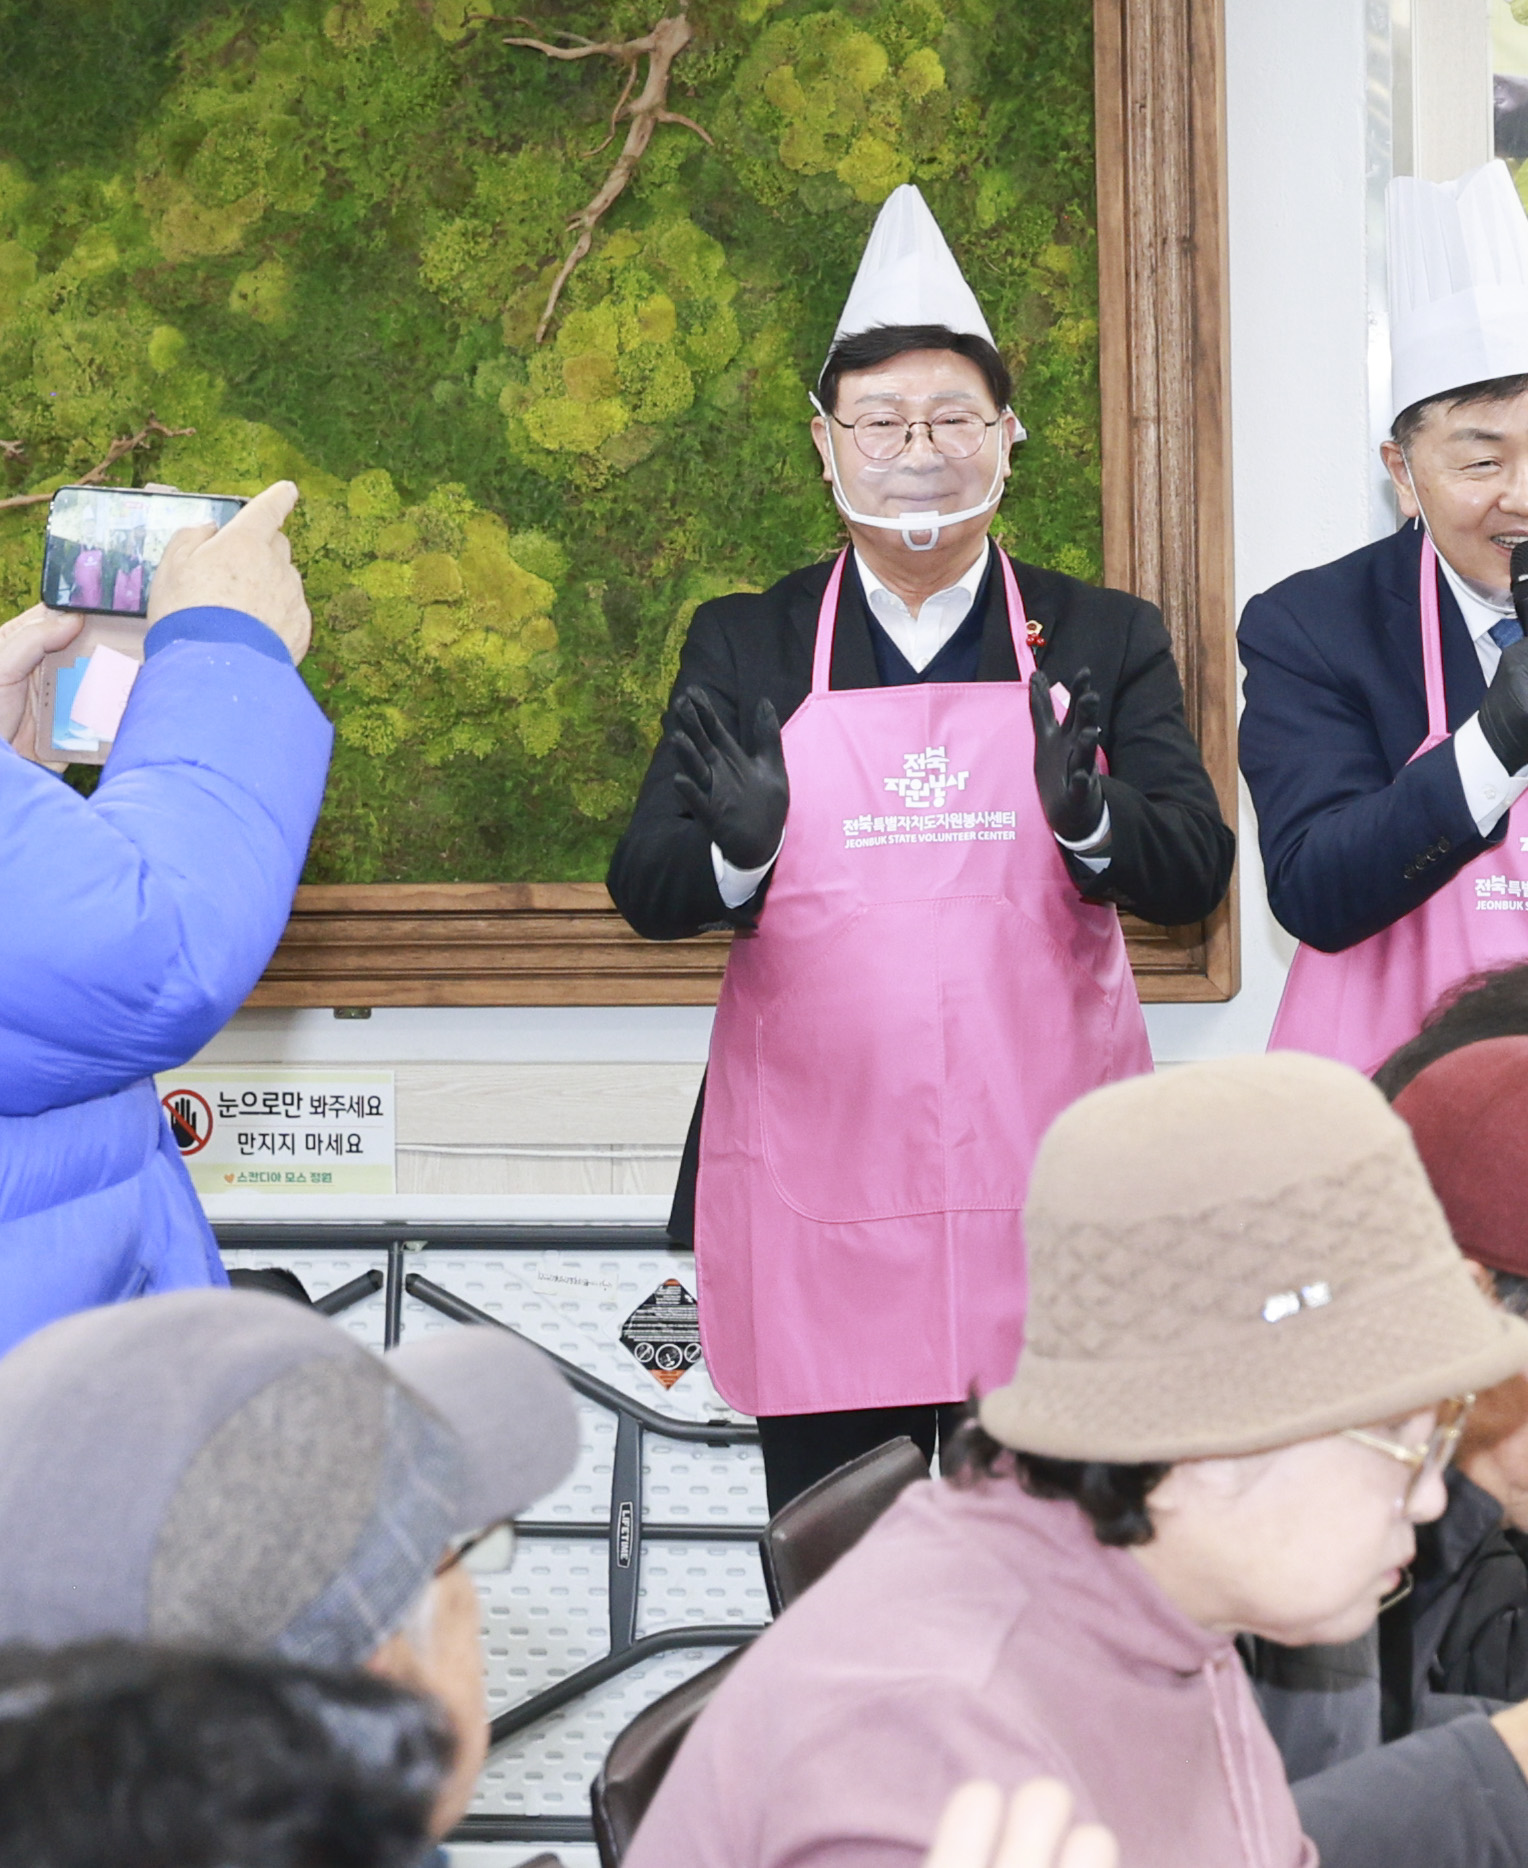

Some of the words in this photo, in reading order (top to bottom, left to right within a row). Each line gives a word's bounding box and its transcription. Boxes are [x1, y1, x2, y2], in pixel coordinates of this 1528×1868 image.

[903, 746, 950, 777] 전북
[883, 771, 969, 809] 자원봉사
[842, 811, 1016, 836] 전북특별자치도자원봉사센터
[844, 835, 887, 849] JEONBUK
[888, 834, 918, 844] STATE
[918, 831, 977, 843] VOLUNTEER
[978, 830, 1016, 842] CENTER
[1475, 899, 1524, 911] JEONBUK
[217, 1091, 303, 1119] 눈으로만
[309, 1094, 384, 1119] 봐주세요
[237, 1132, 296, 1156] 만지지
[305, 1132, 364, 1156] 마세요
[285, 1171, 307, 1183] 모스
[310, 1171, 333, 1184] 정원
[620, 1510, 631, 1560] LIFETIME
